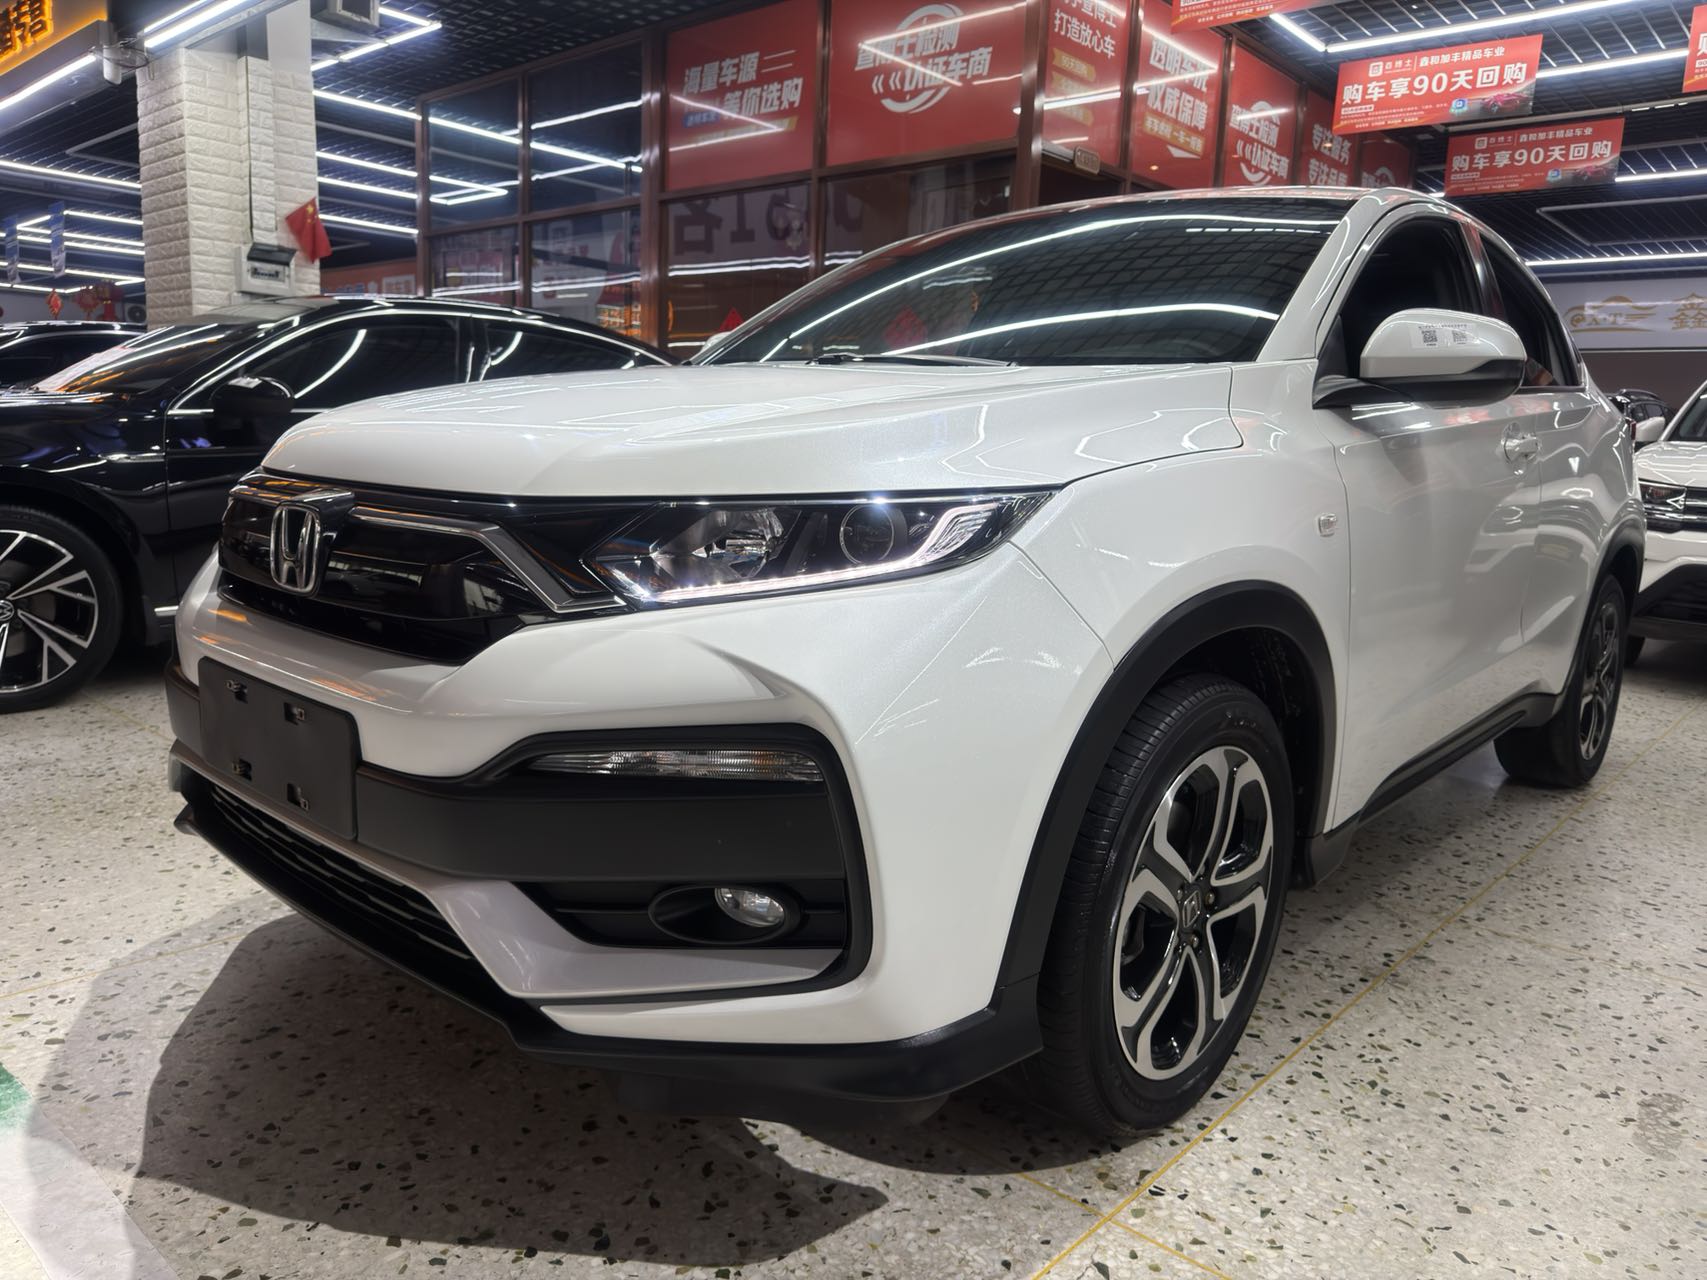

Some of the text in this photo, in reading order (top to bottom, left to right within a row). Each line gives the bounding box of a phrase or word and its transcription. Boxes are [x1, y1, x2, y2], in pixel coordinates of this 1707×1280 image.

[1054, 10, 1117, 59] 打造放心车
[682, 51, 760, 96] 海量车源
[1342, 62, 1528, 106] 购车享90天回购
[723, 77, 804, 120] 等你选购
[1147, 83, 1209, 131] 权威保障
[1452, 140, 1613, 173] 购车享90天回购
